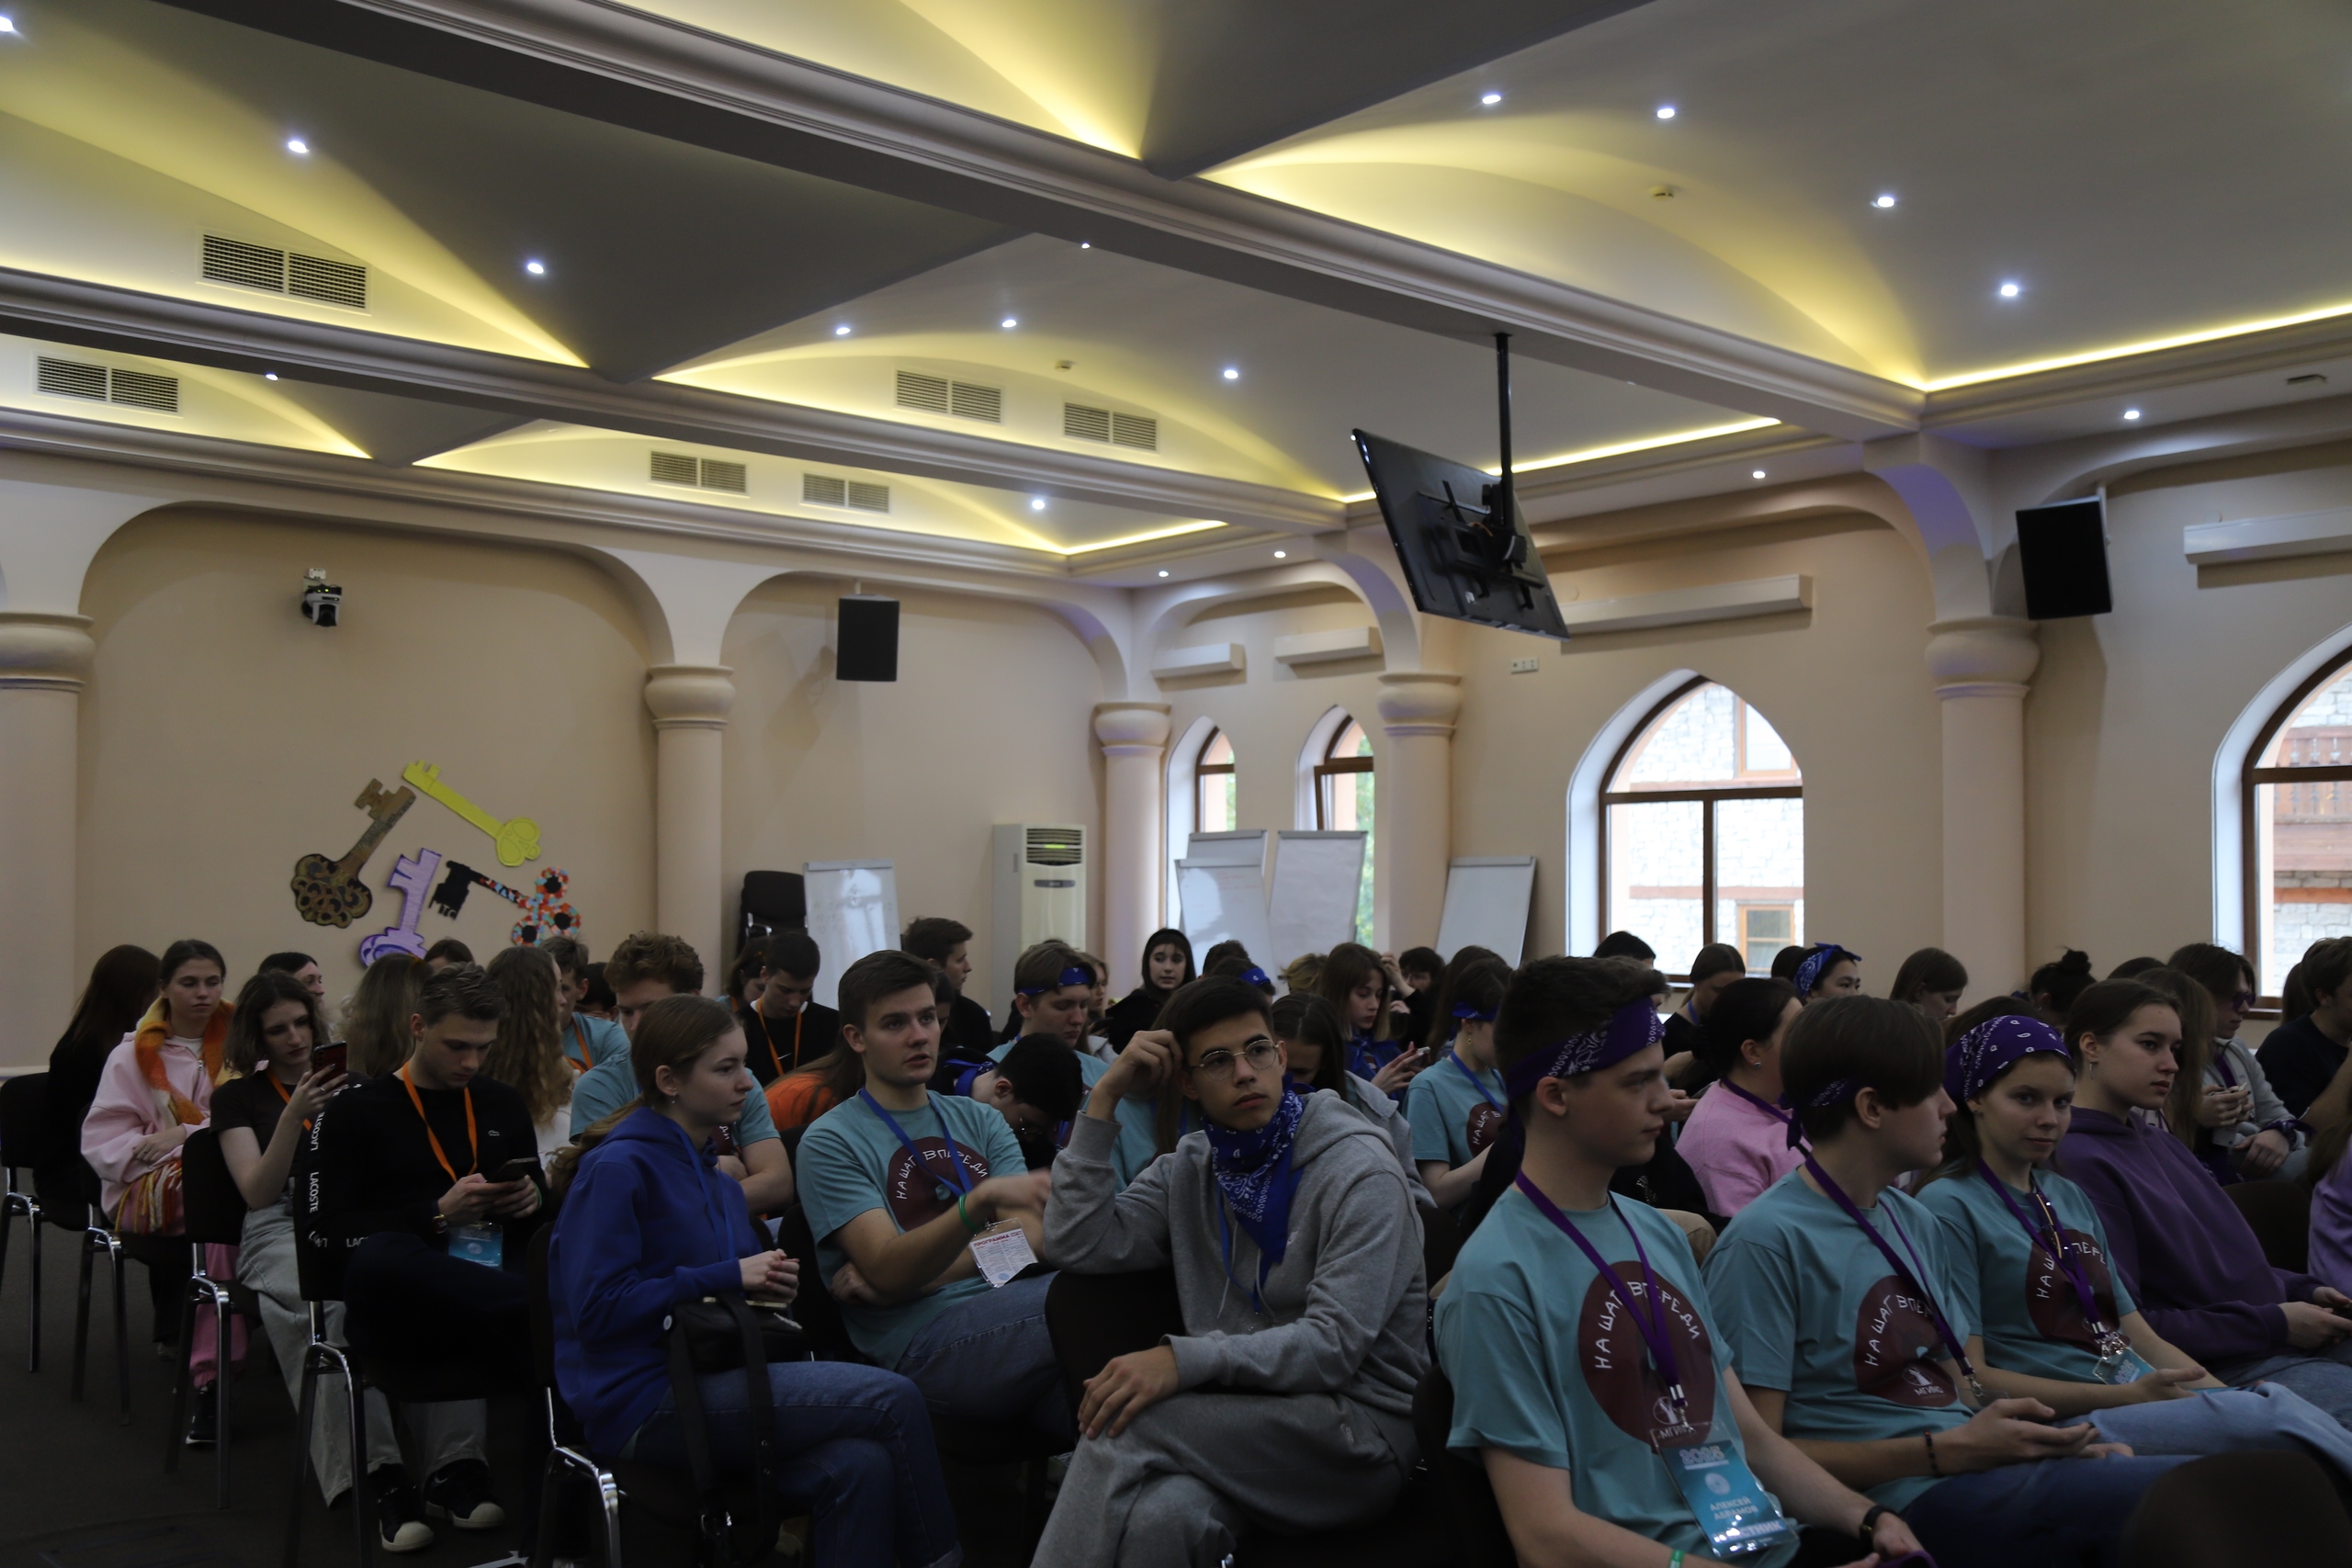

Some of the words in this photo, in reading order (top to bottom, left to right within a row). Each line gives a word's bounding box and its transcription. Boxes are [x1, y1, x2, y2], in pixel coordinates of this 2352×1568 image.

[310, 1111, 325, 1151] LACOSTE
[1472, 1129, 1482, 1145] НА
[900, 1155, 917, 1179] ШАГ
[310, 1171, 319, 1213] LACOSTE
[896, 1180, 908, 1200] НА
[2035, 1275, 2052, 1299] НА
[1598, 1289, 1623, 1331] ШАГ
[1627, 1280, 1701, 1339] ВПРЕДИ
[1871, 1294, 1893, 1334] ШАГ
[1895, 1294, 1933, 1317] ВПЕР
[1594, 1337, 1613, 1369] НА
[1863, 1338, 1881, 1367] НА
[1914, 1385, 1944, 1396] МГИМО
[1679, 1445, 1725, 1465] 2025
[1710, 1495, 1752, 1512] АЛЕКСЕЙ
[1713, 1520, 1783, 1543] СТНИК
